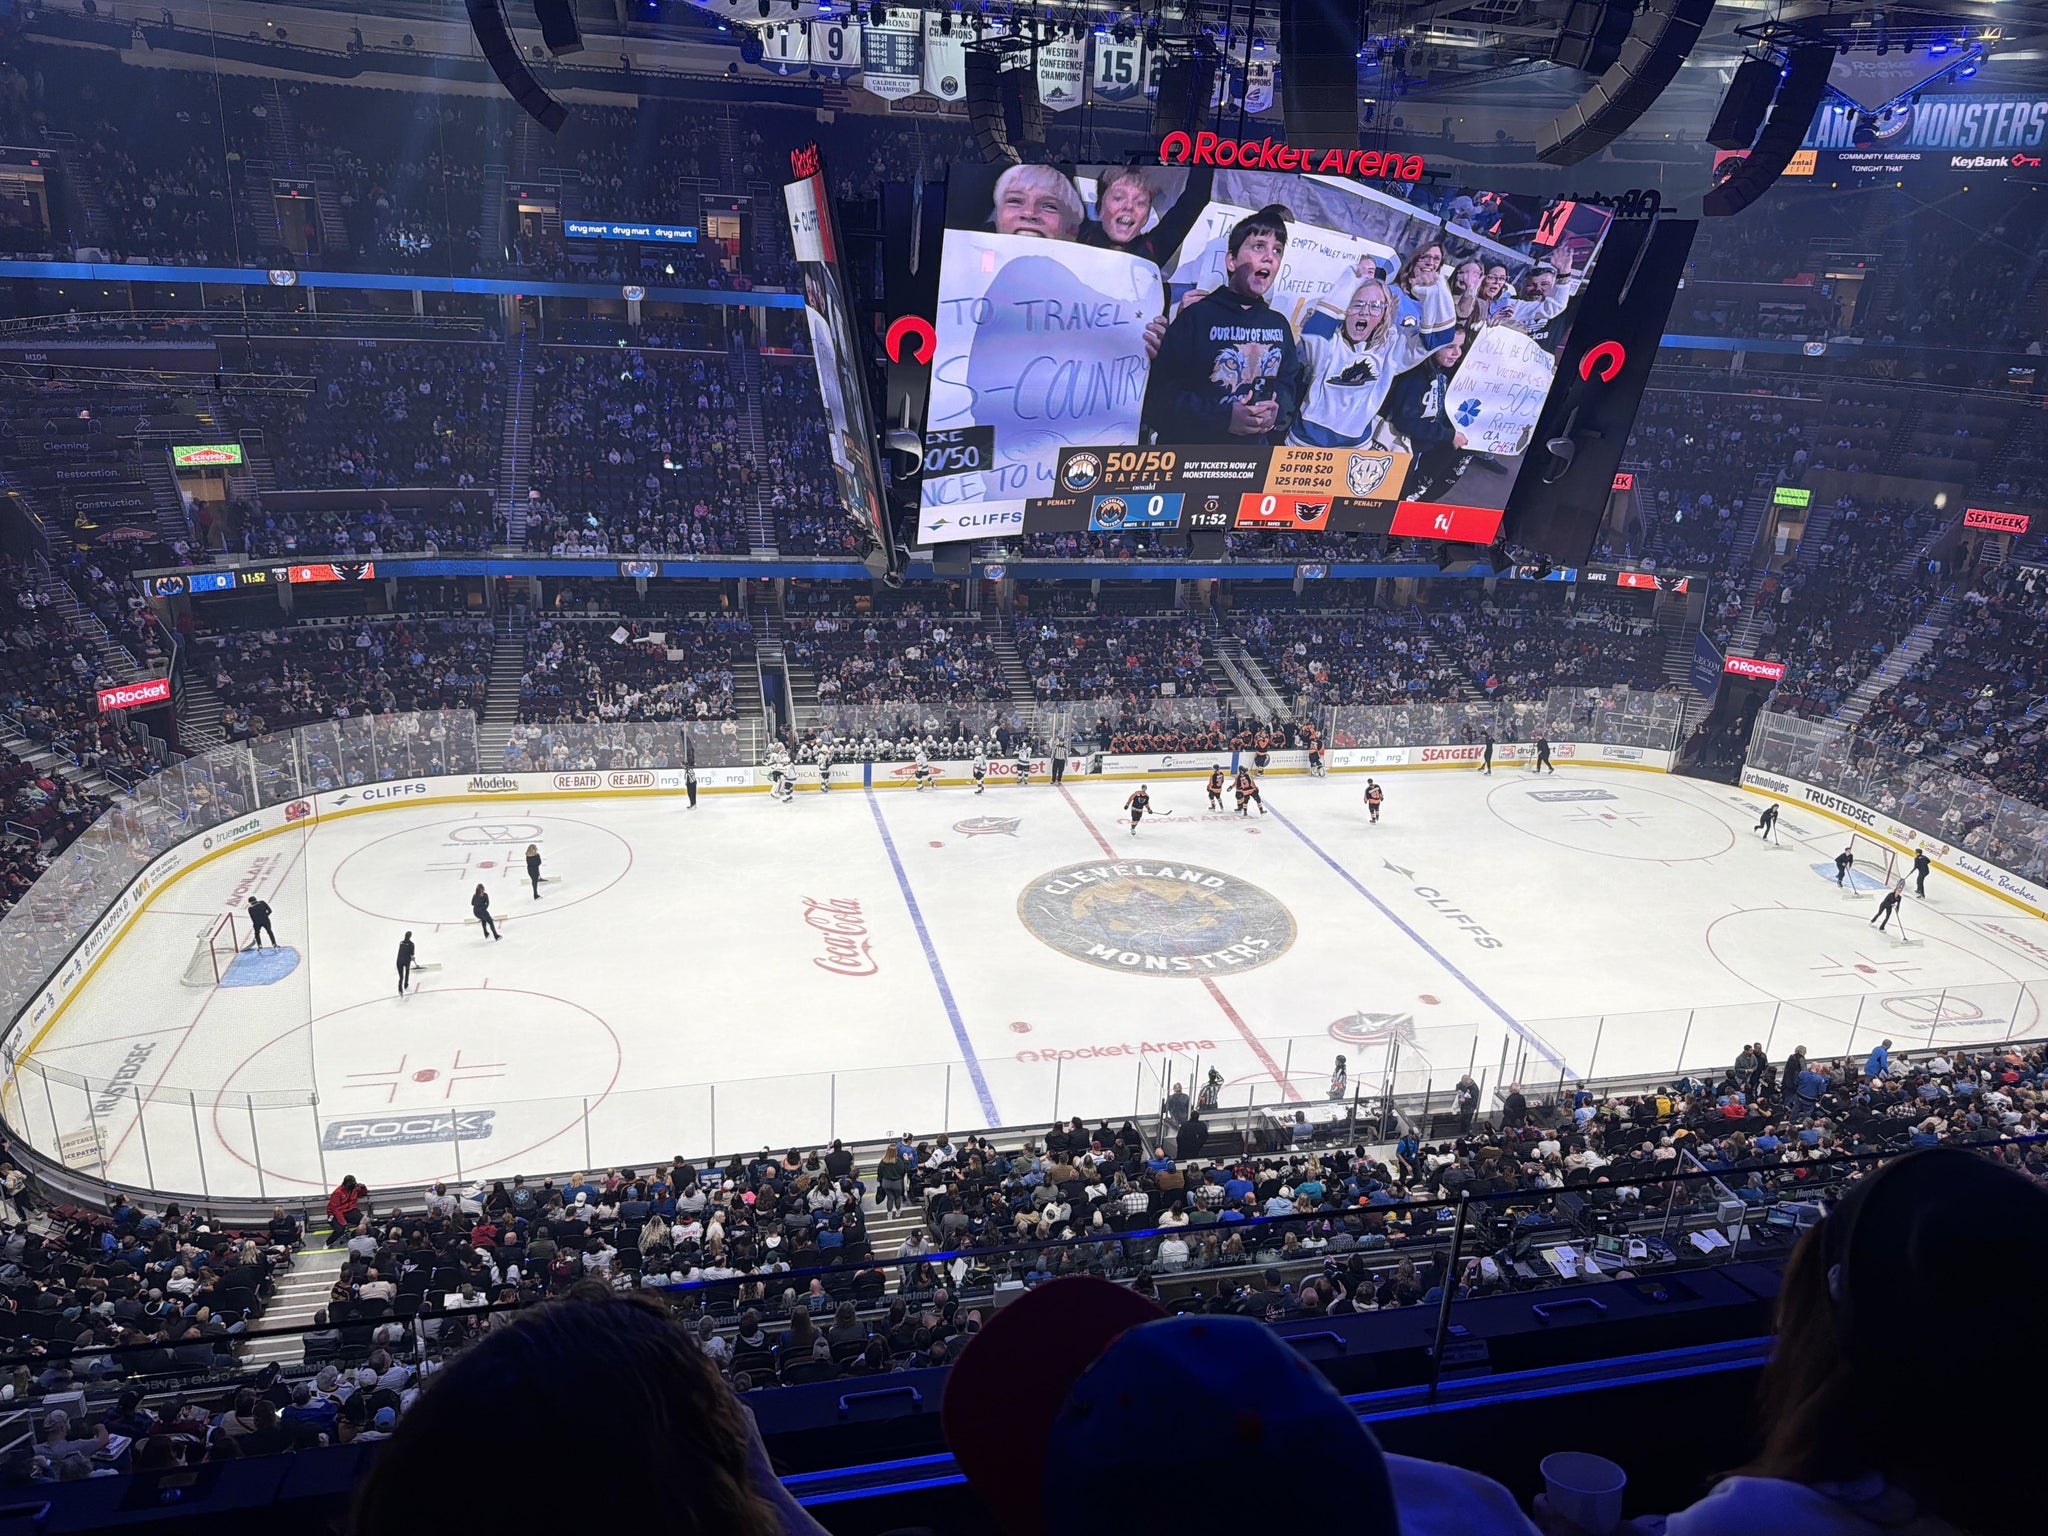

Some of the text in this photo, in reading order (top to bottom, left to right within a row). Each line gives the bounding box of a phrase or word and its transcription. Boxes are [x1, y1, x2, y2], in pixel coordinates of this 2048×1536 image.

[828, 27, 844, 61] 9
[1045, 46, 1079, 58] WESTERN
[1039, 58, 1084, 71] CONFERENCE
[1101, 49, 1134, 84] 15
[1040, 69, 1081, 82] CHAMPIONS
[1905, 102, 2048, 148] MONSTERS
[1193, 131, 1425, 181] Rocket Arena
[1951, 156, 2009, 168] KeyBank
[569, 223, 608, 236] drug mart
[612, 226, 650, 238] drug mart
[655, 228, 692, 239] drug mart
[1291, 237, 1319, 251] EMPTY
[1277, 263, 1313, 293] RAFFLE
[941, 296, 1130, 331] TO TRAVEL
[1209, 325, 1230, 341] OUR
[1230, 325, 1250, 342] LADY
[1250, 328, 1261, 342] OF
[24, 353, 48, 361] M104
[190, 453, 226, 462] SERVPRO
[1105, 451, 1177, 472] 50/50
[1286, 450, 1333, 462] 5 FOR $10
[1184, 461, 1257, 470] BUY TICKETS NOW AT
[1279, 463, 1334, 475] 50 FOR $20
[56, 468, 121, 479] Restoration.
[989, 463, 1028, 492] TO
[1104, 471, 1174, 483] RAFFLE
[1132, 482, 1156, 491] oswald
[1274, 476, 1331, 487] 125 FOR $40
[75, 497, 144, 510] Construction.
[1047, 498, 1076, 507] PENALTY
[1147, 495, 1164, 516] 0
[1259, 495, 1277, 516] 0
[1353, 500, 1383, 508] PENALTY
[958, 511, 1023, 528] CLIFFS
[1190, 513, 1227, 525] 11:52
[1967, 511, 2026, 531] SEATGEEK
[241, 572, 266, 584] 11:52
[1587, 573, 1607, 582] SAVES
[1628, 575, 1636, 585] 4
[1693, 653, 1721, 673] LECOM
[1739, 661, 1781, 677] Rocket
[115, 682, 167, 705] Rocket
[1421, 746, 1485, 762] SEATGEEK
[1517, 746, 1536, 756] drug
[989, 760, 1046, 775] Rocet
[473, 776, 512, 790] Modelo
[362, 782, 427, 801] CLIFFS
[1805, 787, 1876, 827] TRUSTEDSEC
[216, 818, 260, 843] truenorth
[1043, 863, 1227, 897] CLEVELAND
[132, 876, 151, 903] WM
[1413, 886, 1504, 950] CLIFFS
[89, 904, 124, 951] HITS HAPPEN
[1085, 934, 1272, 972] MONSTERS
[1040, 1037, 1217, 1064] Rocket Arena
[76, 1145, 105, 1157] PATRL
